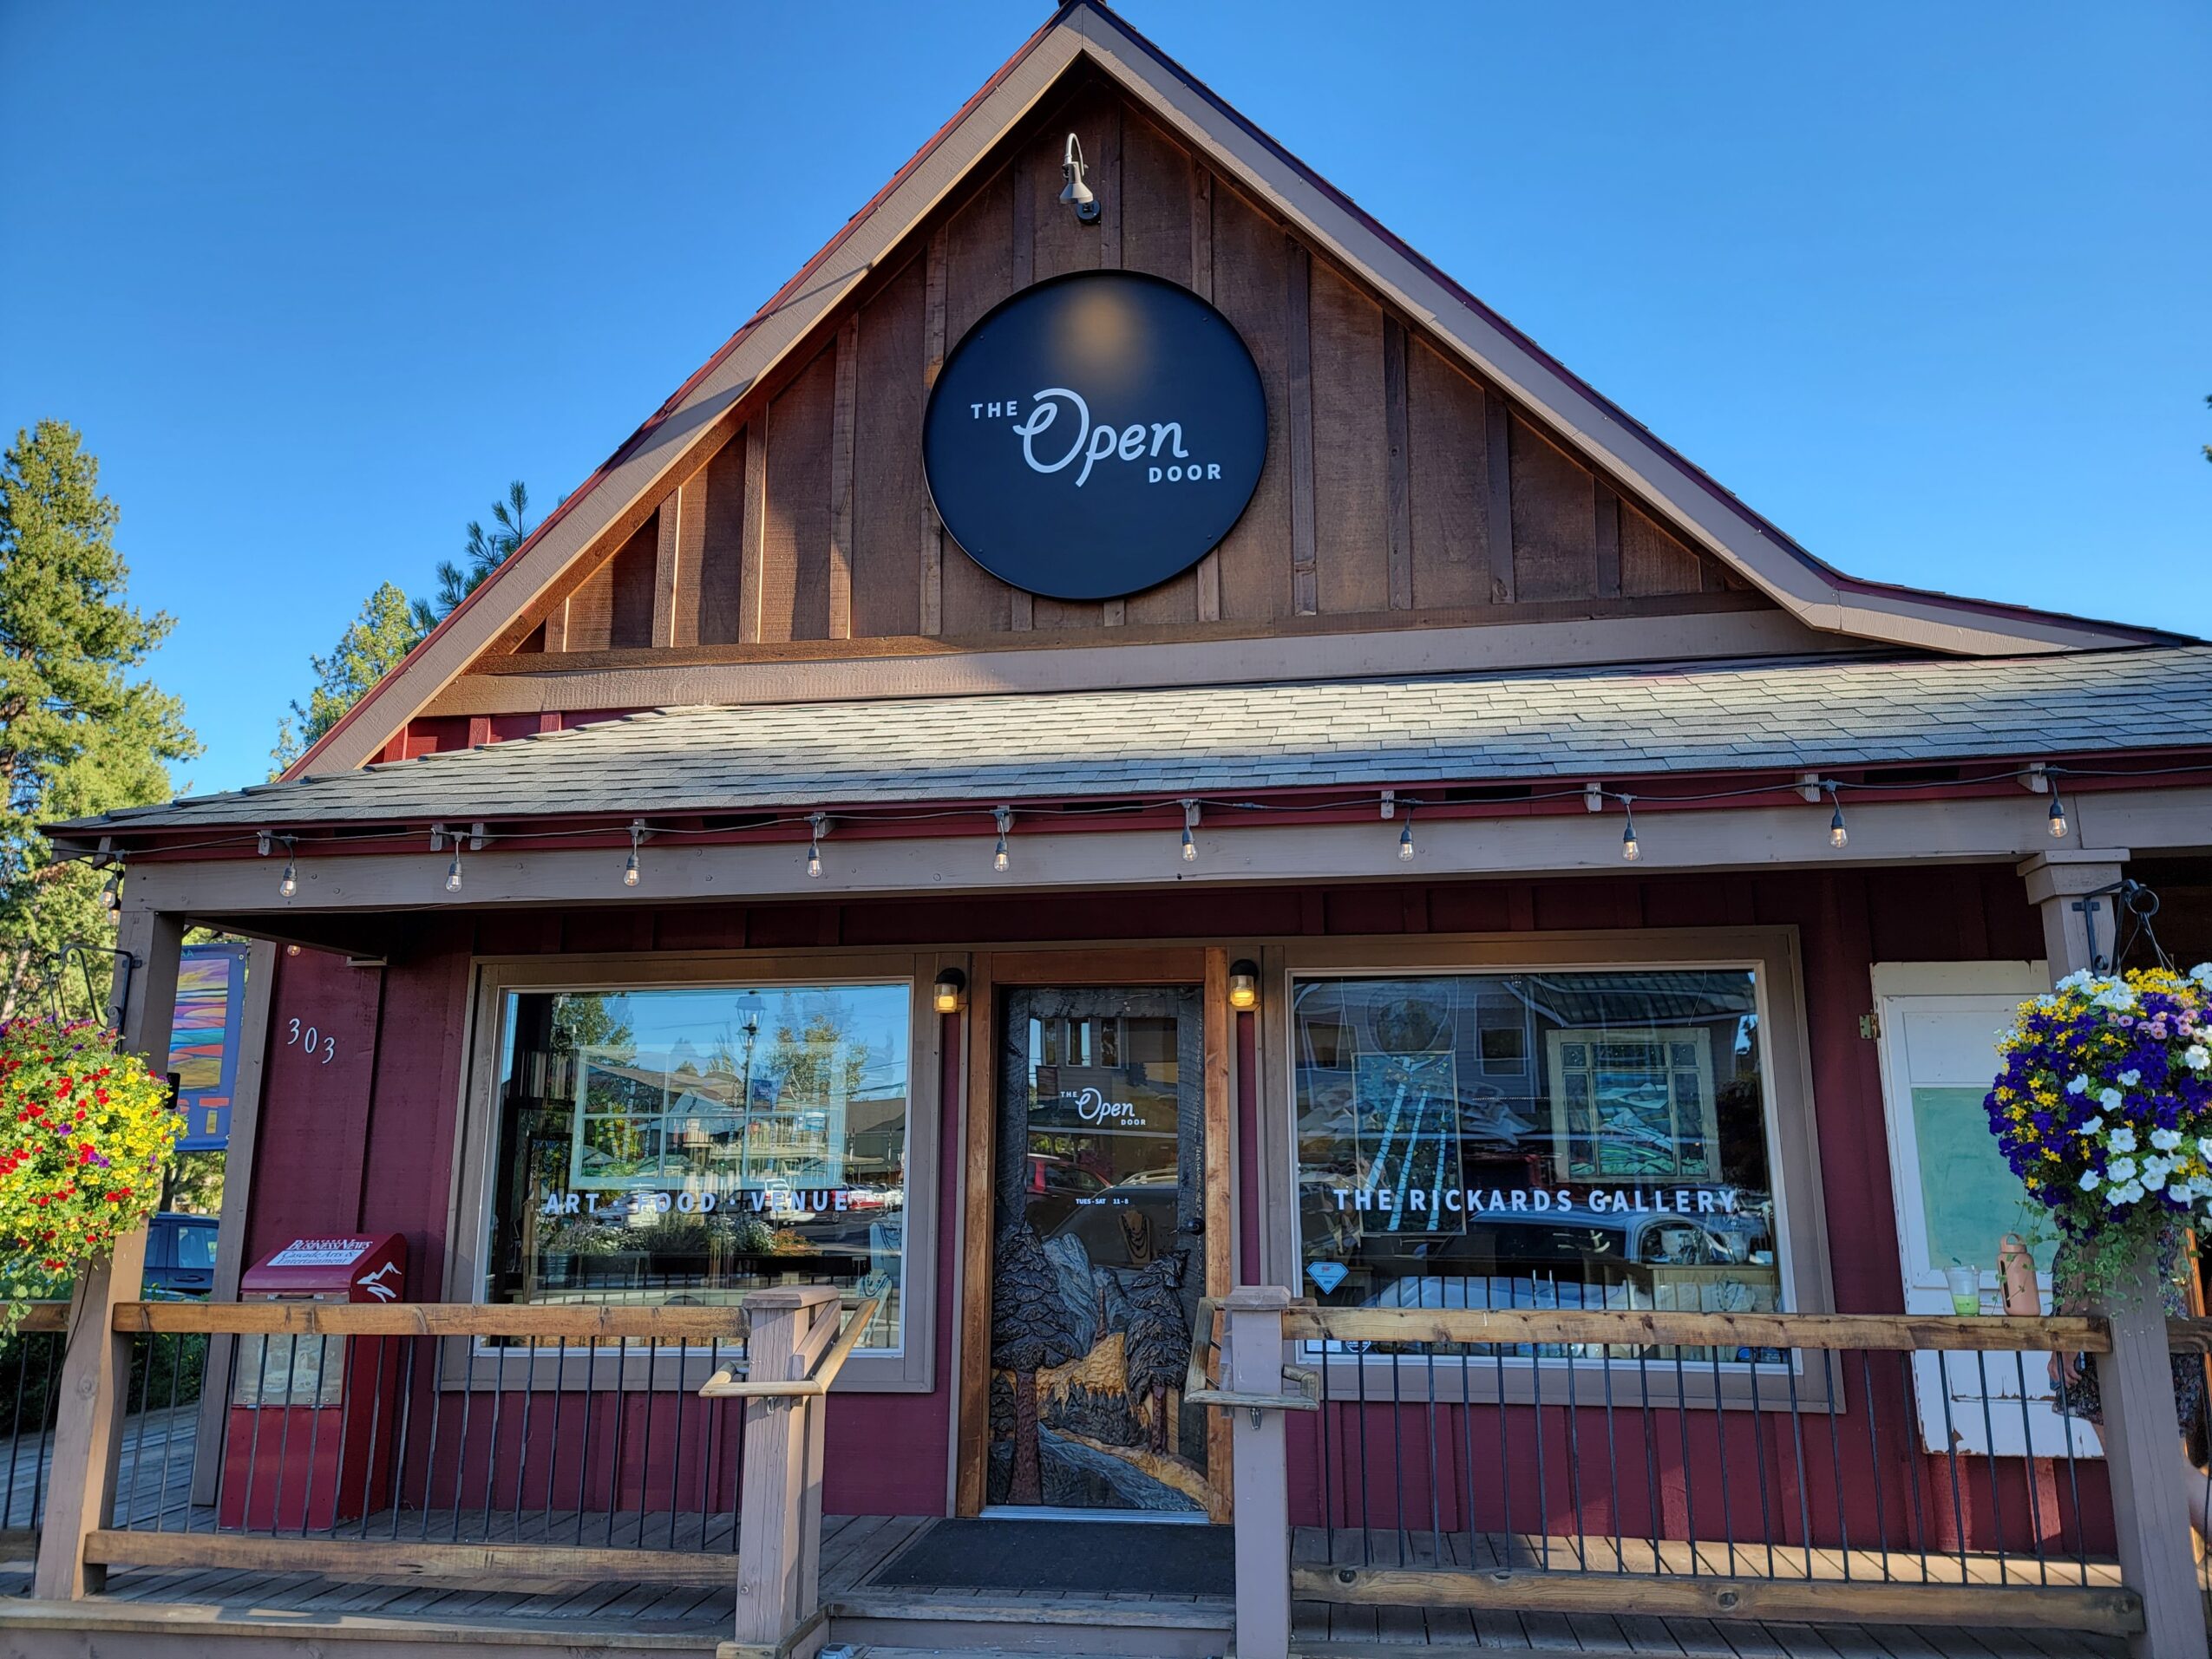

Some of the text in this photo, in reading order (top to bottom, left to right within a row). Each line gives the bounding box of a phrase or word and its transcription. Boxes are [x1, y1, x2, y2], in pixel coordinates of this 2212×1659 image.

[970, 400, 1018, 419] THE
[1012, 388, 1189, 488] Open
[1149, 463, 1221, 484] DOOR
[287, 1017, 336, 1064] 303
[1075, 1087, 1135, 1125] Open
[545, 1191, 849, 1214] ART FOOD VENUE
[1333, 1189, 1737, 1213] THE RICKARDS GALLERY
